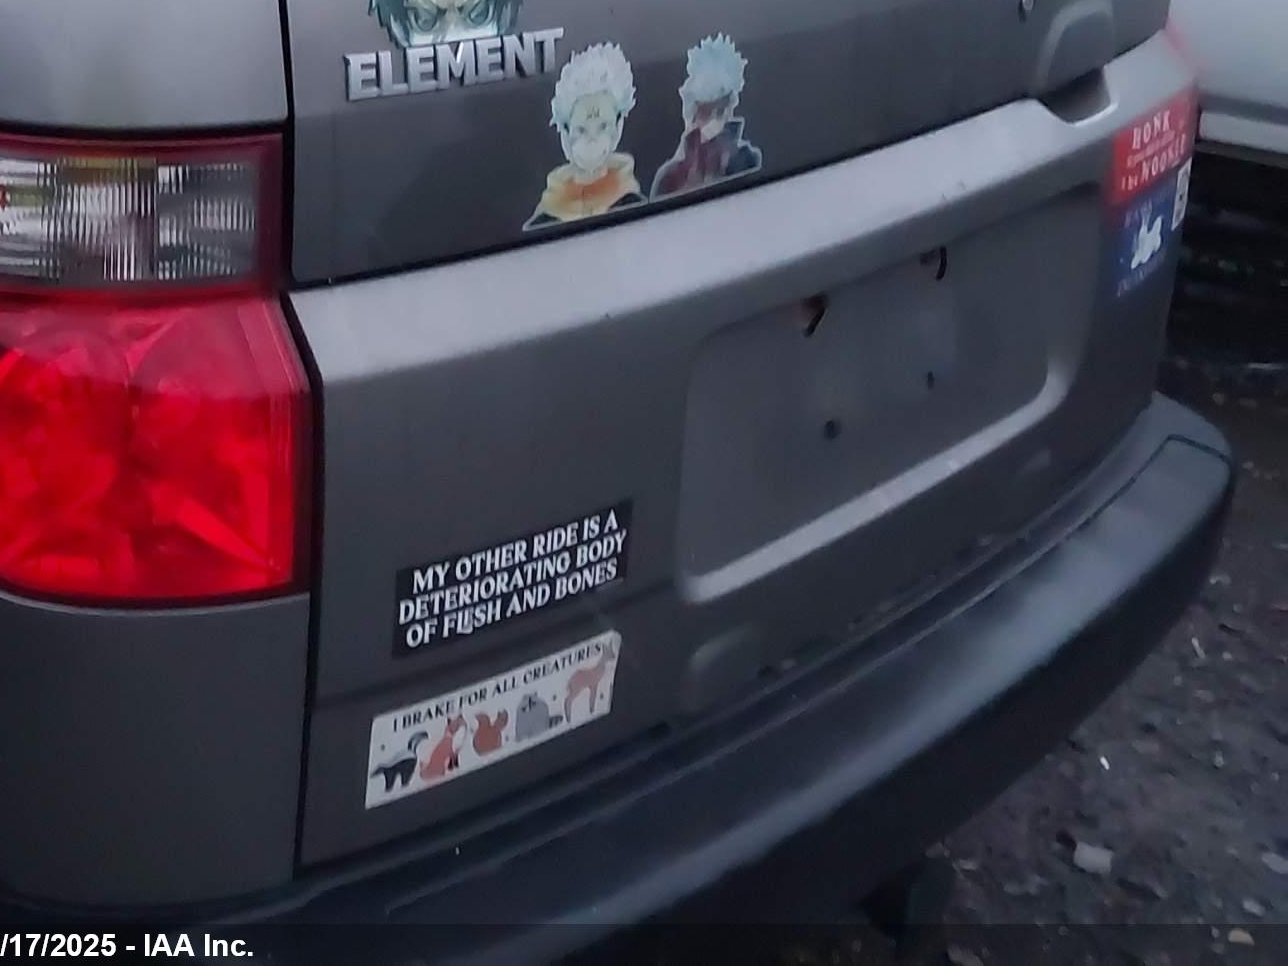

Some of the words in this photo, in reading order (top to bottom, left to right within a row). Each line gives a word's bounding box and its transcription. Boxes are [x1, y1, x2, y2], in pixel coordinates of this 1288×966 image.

[344, 28, 564, 102] ELEMENT
[1132, 110, 1171, 150] HONK
[398, 553, 571, 625] DETERIORATING
[576, 529, 627, 568] BODY
[412, 561, 450, 594] MY
[455, 539, 528, 581] OTHER
[532, 522, 578, 559] RIDE
[583, 515, 600, 541] IS
[604, 509, 618, 533] A
[406, 619, 438, 648] OF
[506, 584, 550, 618] AND
[555, 558, 618, 600] BONES
[402, 698, 456, 728] BRAKE
[458, 688, 487, 710] FOR
[492, 676, 518, 695] ALL
[523, 641, 602, 684] CREATURES
